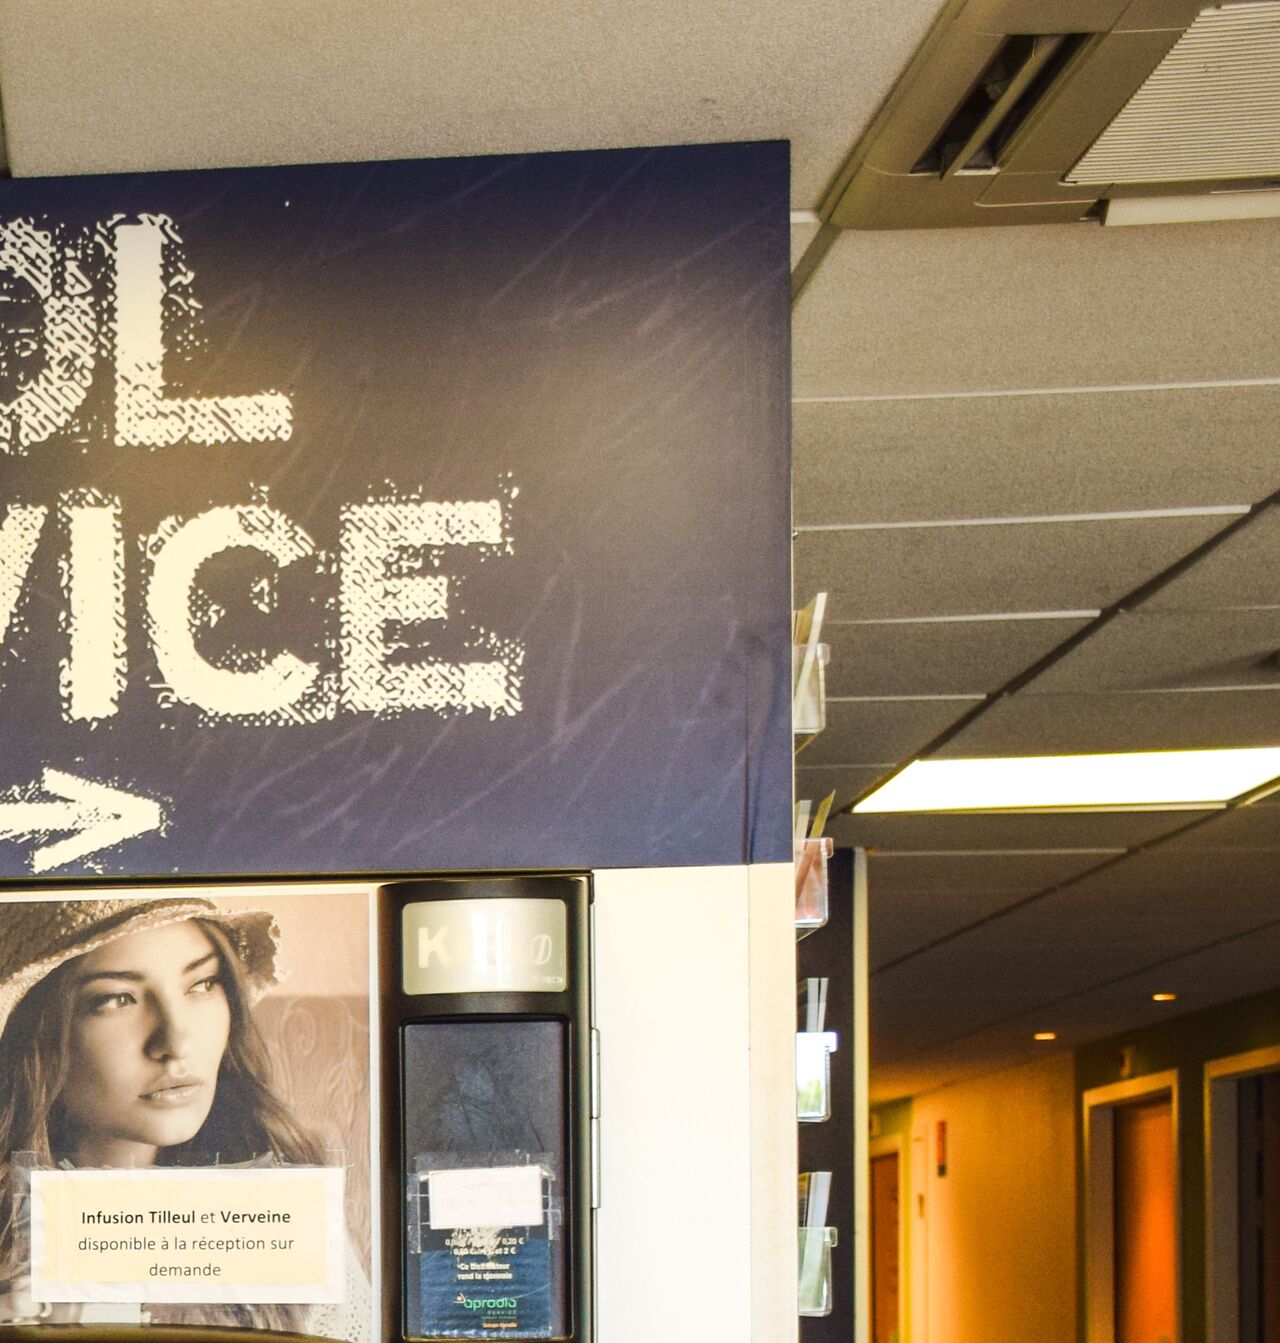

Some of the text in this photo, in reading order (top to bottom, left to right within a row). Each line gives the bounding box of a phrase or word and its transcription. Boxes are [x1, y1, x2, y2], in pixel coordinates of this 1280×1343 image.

[82, 1210, 291, 1225] Infusion Tilleul et Verveine
[78, 1236, 294, 1253] disponible à la réception sur
[149, 1263, 221, 1277] demande
